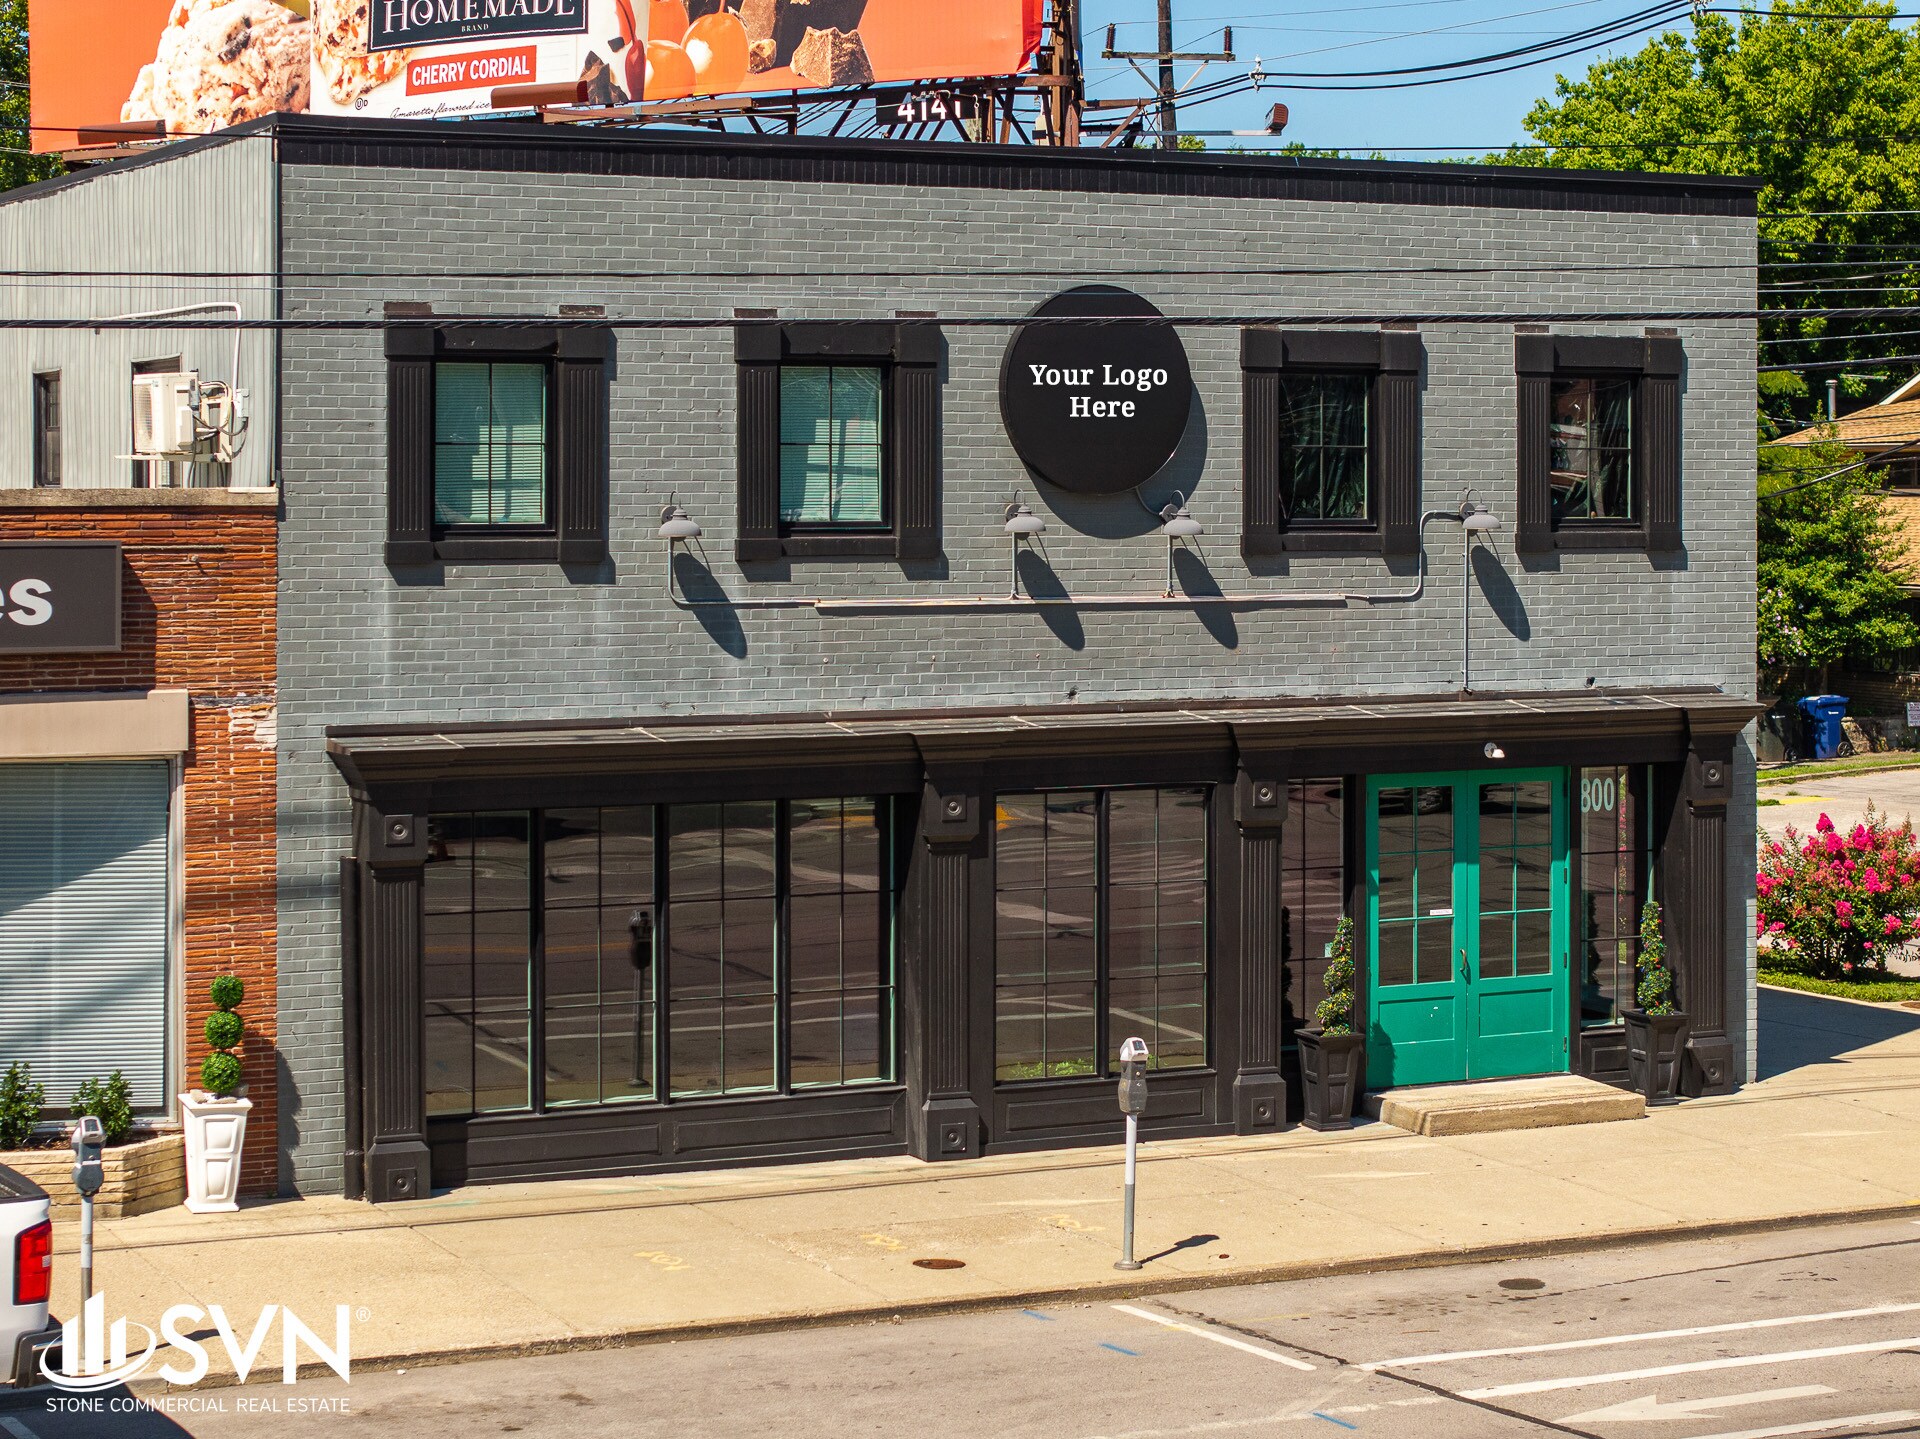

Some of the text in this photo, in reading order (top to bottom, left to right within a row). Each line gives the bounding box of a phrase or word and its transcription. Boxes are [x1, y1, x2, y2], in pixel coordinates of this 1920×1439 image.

[461, 23, 489, 32] BRAND
[412, 55, 530, 86] CHERRY CORDIAL
[897, 99, 961, 122] 4141
[1029, 364, 1168, 392] Your Logo
[1069, 396, 1136, 418] Here
[0, 578, 53, 626] s
[1581, 777, 1615, 813] 800
